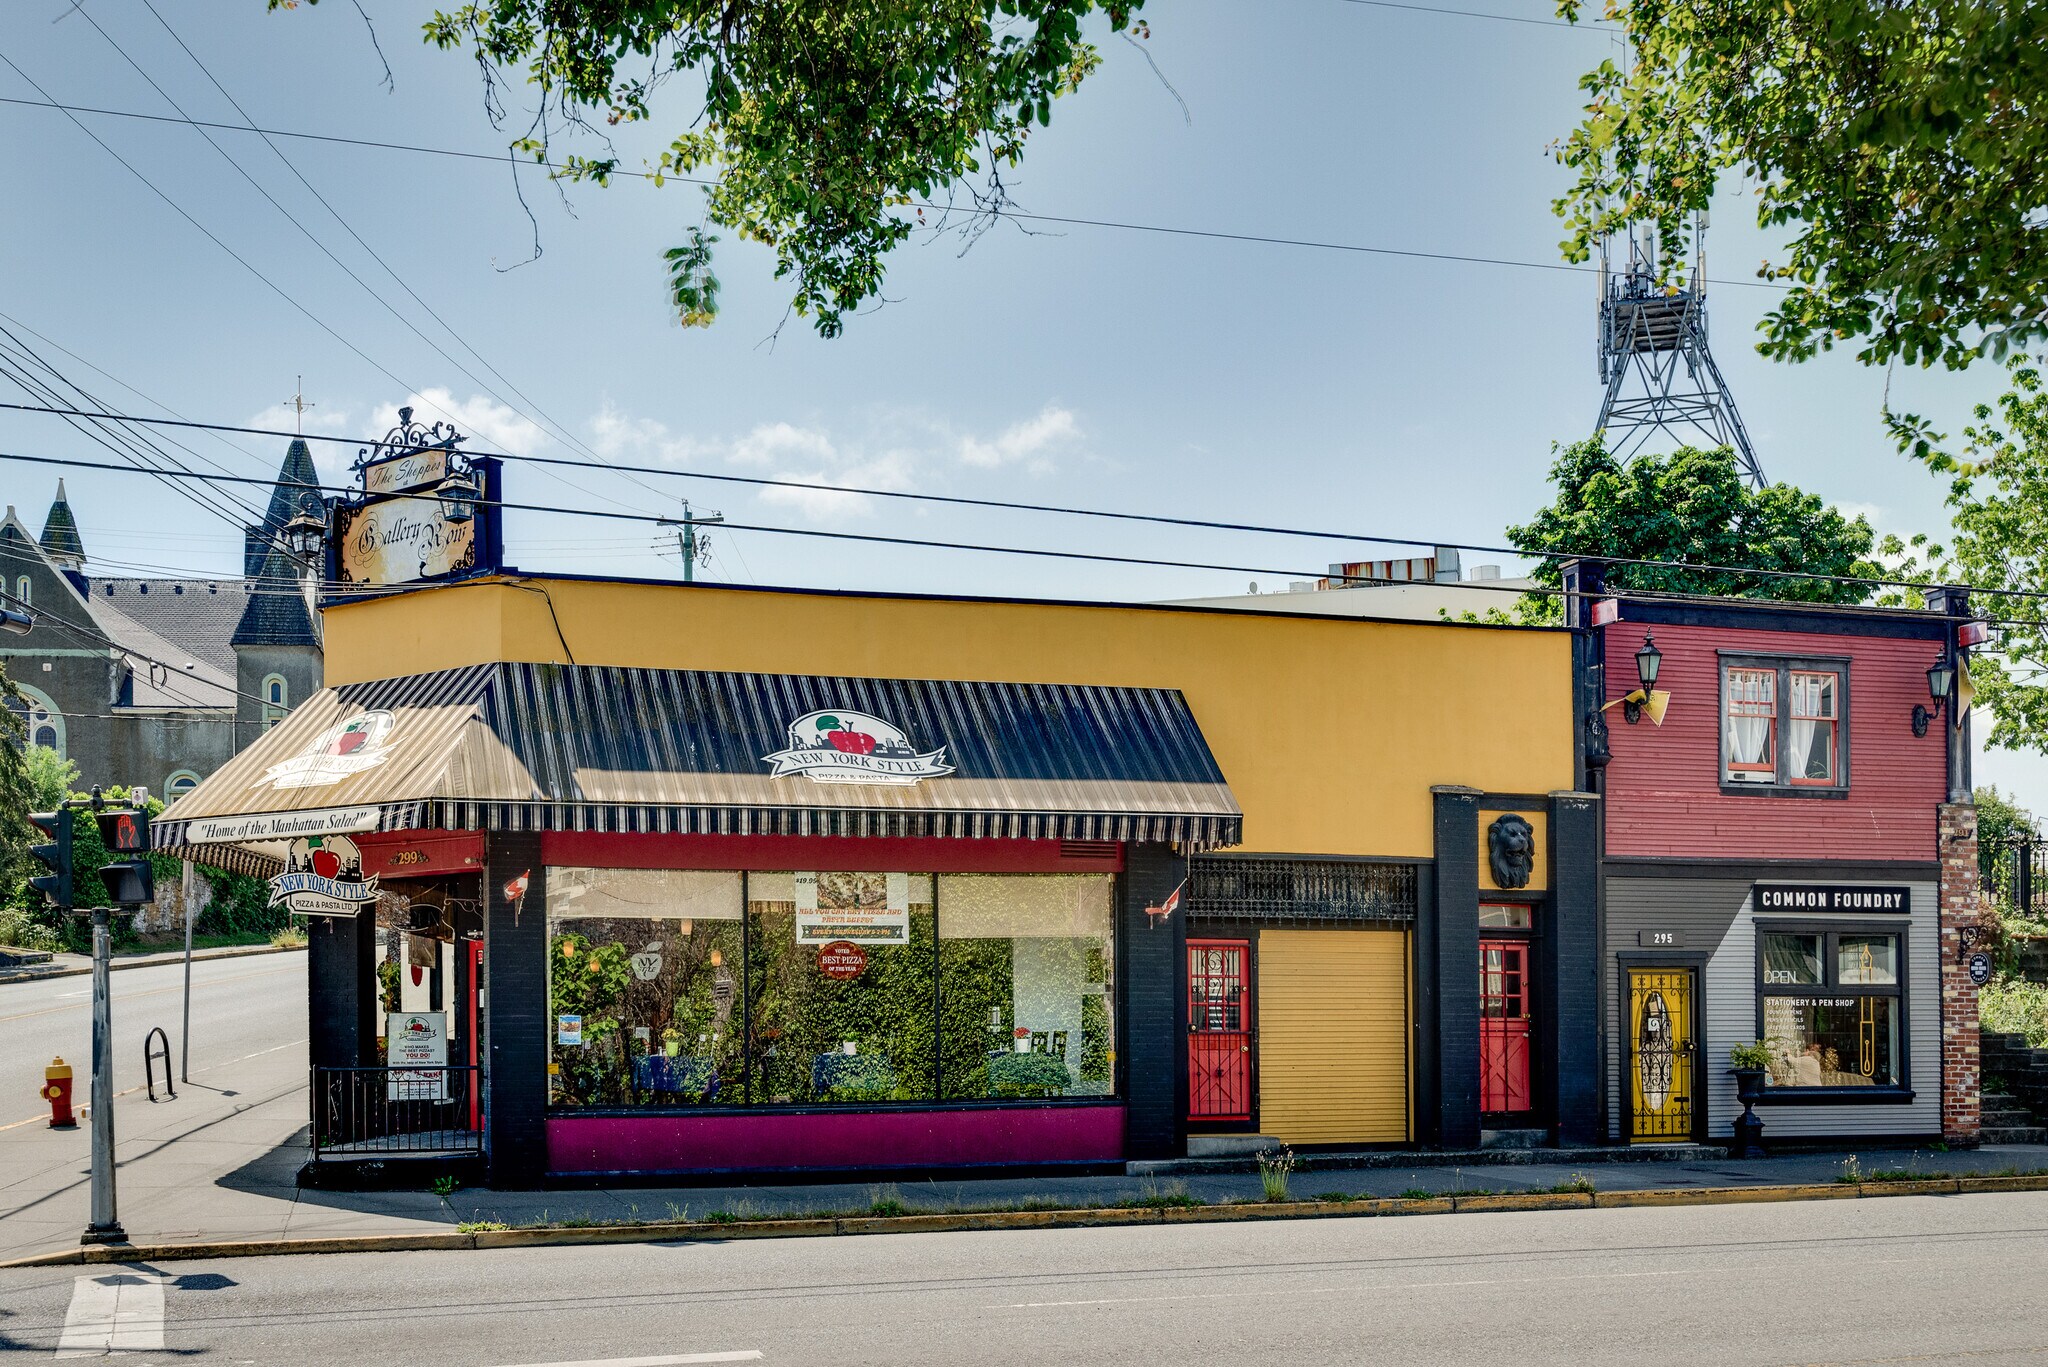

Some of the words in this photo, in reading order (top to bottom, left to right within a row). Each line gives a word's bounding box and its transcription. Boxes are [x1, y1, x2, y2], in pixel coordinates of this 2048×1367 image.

[372, 467, 392, 487] The
[395, 460, 441, 481] Shoppes
[354, 513, 422, 558] Gallery
[419, 517, 467, 556] Row
[788, 752, 823, 766] NEW
[827, 752, 871, 768] YORK
[877, 759, 925, 773] STYLE
[202, 824, 234, 838] "Home
[238, 821, 251, 838] of
[251, 820, 267, 834] the
[269, 818, 325, 833] Manhattan
[327, 812, 367, 828] Salad"
[1954, 829, 1969, 837] 291
[399, 851, 418, 865] 299
[279, 873, 304, 892] NEW
[307, 874, 337, 894] YORK
[335, 882, 368, 899] STYLE
[295, 899, 314, 907] PIZZA
[321, 901, 340, 910] PASTA
[1762, 891, 1827, 907] COMMON
[1834, 892, 1902, 908] FOUNDRY
[1654, 933, 1673, 944] 295
[822, 956, 840, 964] BEST
[842, 956, 863, 964] PIZZA
[1764, 970, 1797, 984] OPEN
[1835, 999, 1854, 1007] SHOP
